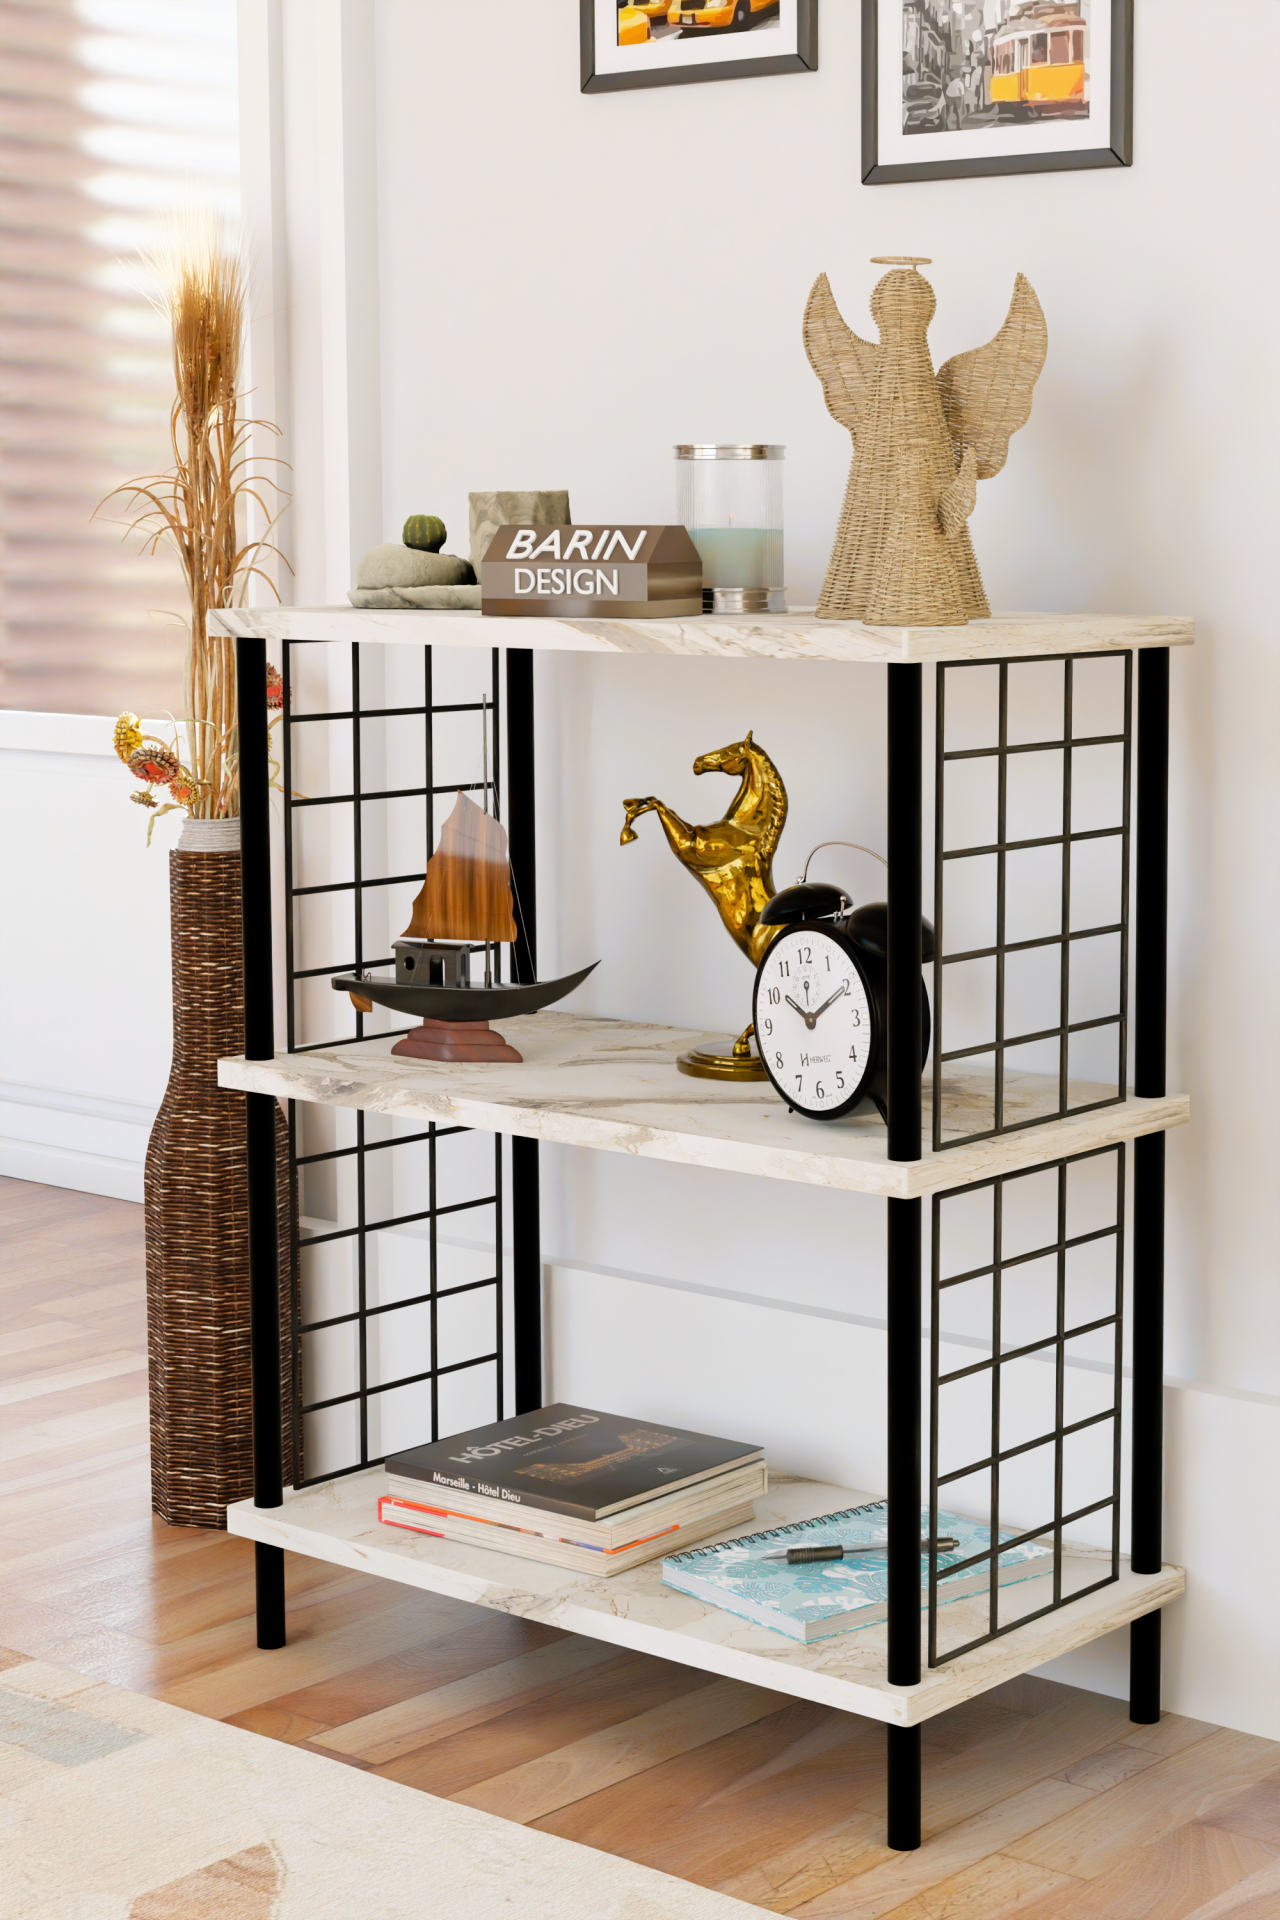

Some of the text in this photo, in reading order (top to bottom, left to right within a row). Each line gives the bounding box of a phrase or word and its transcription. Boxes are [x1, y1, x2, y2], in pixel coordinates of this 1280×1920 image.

[505, 529, 648, 561] BARIN
[514, 568, 619, 595] DESIGN
[797, 947, 812, 964] 12
[825, 955, 830, 972] 1
[779, 961, 790, 977] 11
[768, 987, 780, 1005] 10
[842, 979, 851, 996] 2
[765, 1018, 772, 1035] 9
[852, 1009, 860, 1027] 3
[776, 1052, 784, 1069] 8
[849, 1045, 857, 1062] 4
[795, 1075, 802, 1092] 7
[836, 1071, 844, 1088] 5
[816, 1081, 824, 1099] 6
[447, 1413, 601, 1464] HÔTEL-DIEU
[432, 1471, 470, 1491] Marseille
[477, 1482, 500, 1498] Hôtel
[501, 1488, 521, 1503] Dieu
